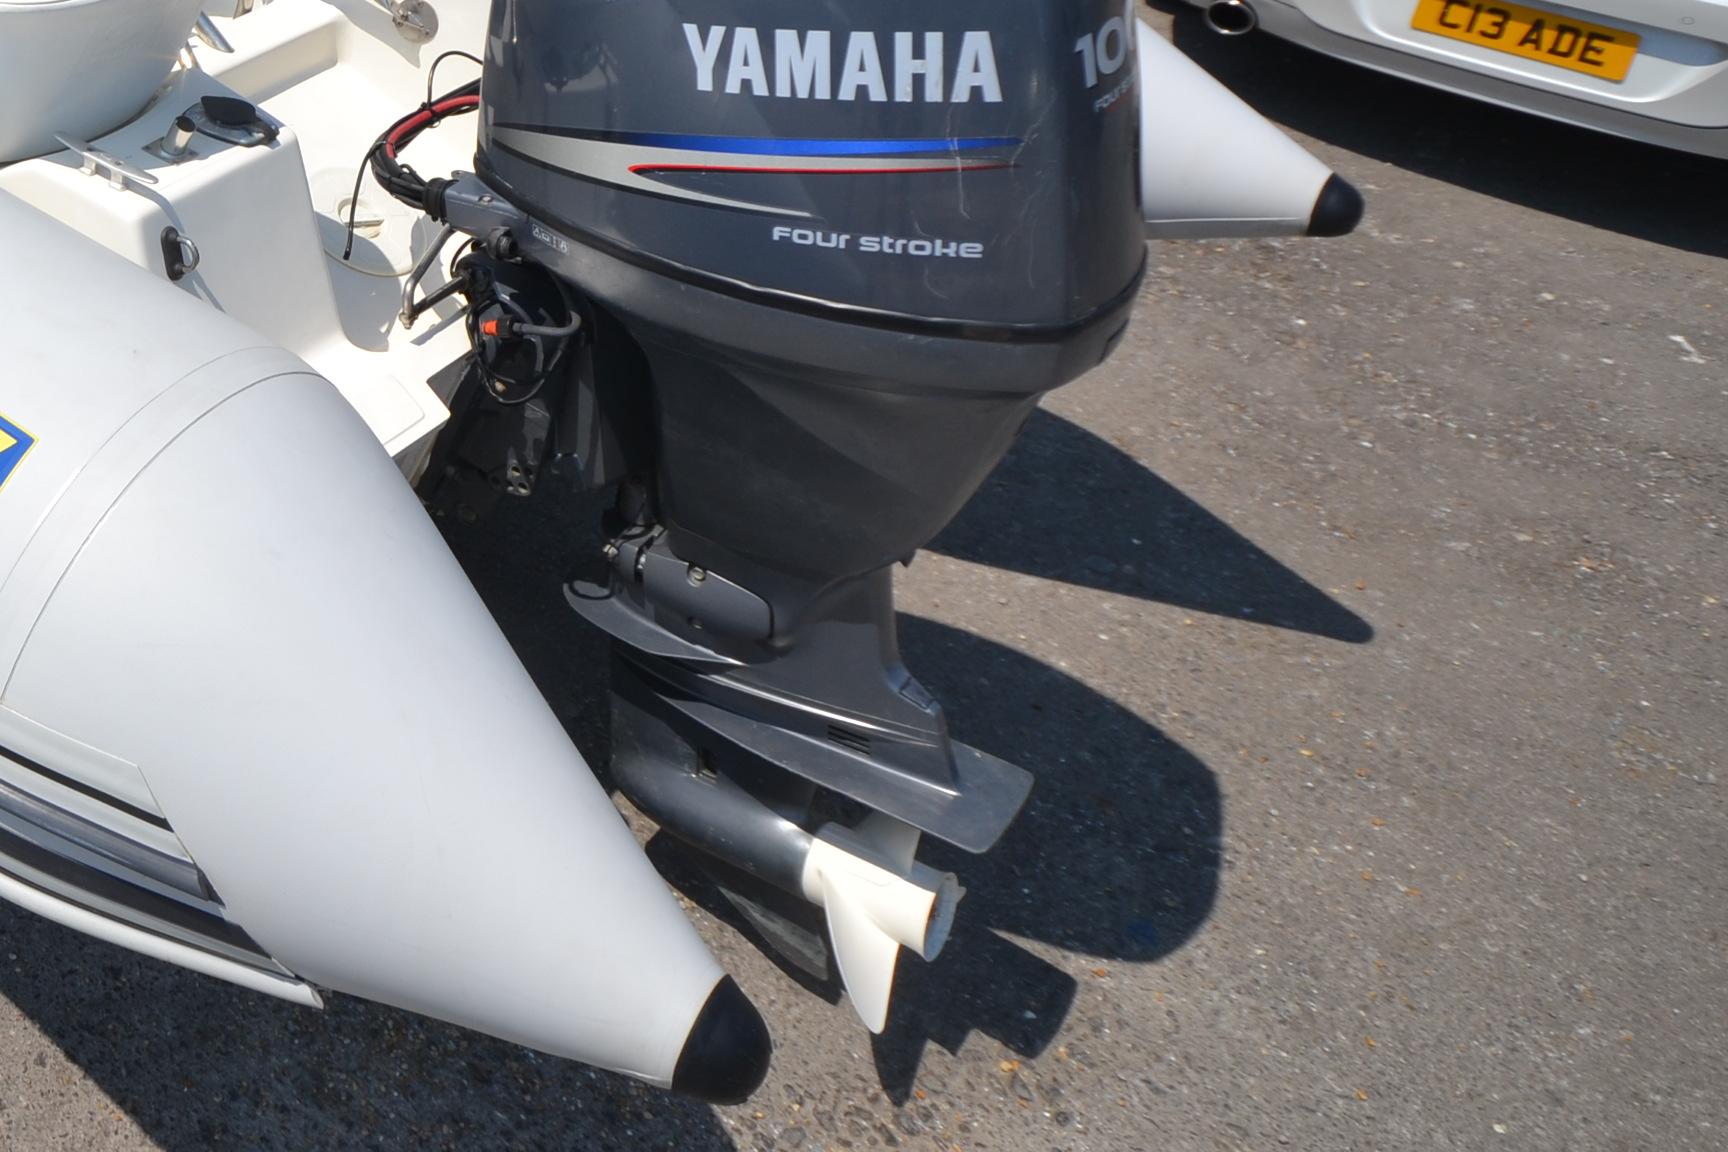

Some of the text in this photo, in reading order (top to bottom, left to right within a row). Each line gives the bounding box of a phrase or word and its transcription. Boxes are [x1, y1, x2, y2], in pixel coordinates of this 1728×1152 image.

[682, 22, 1004, 103] YAMAHA
[1074, 16, 1129, 89] 10
[1518, 18, 1615, 67] ADE
